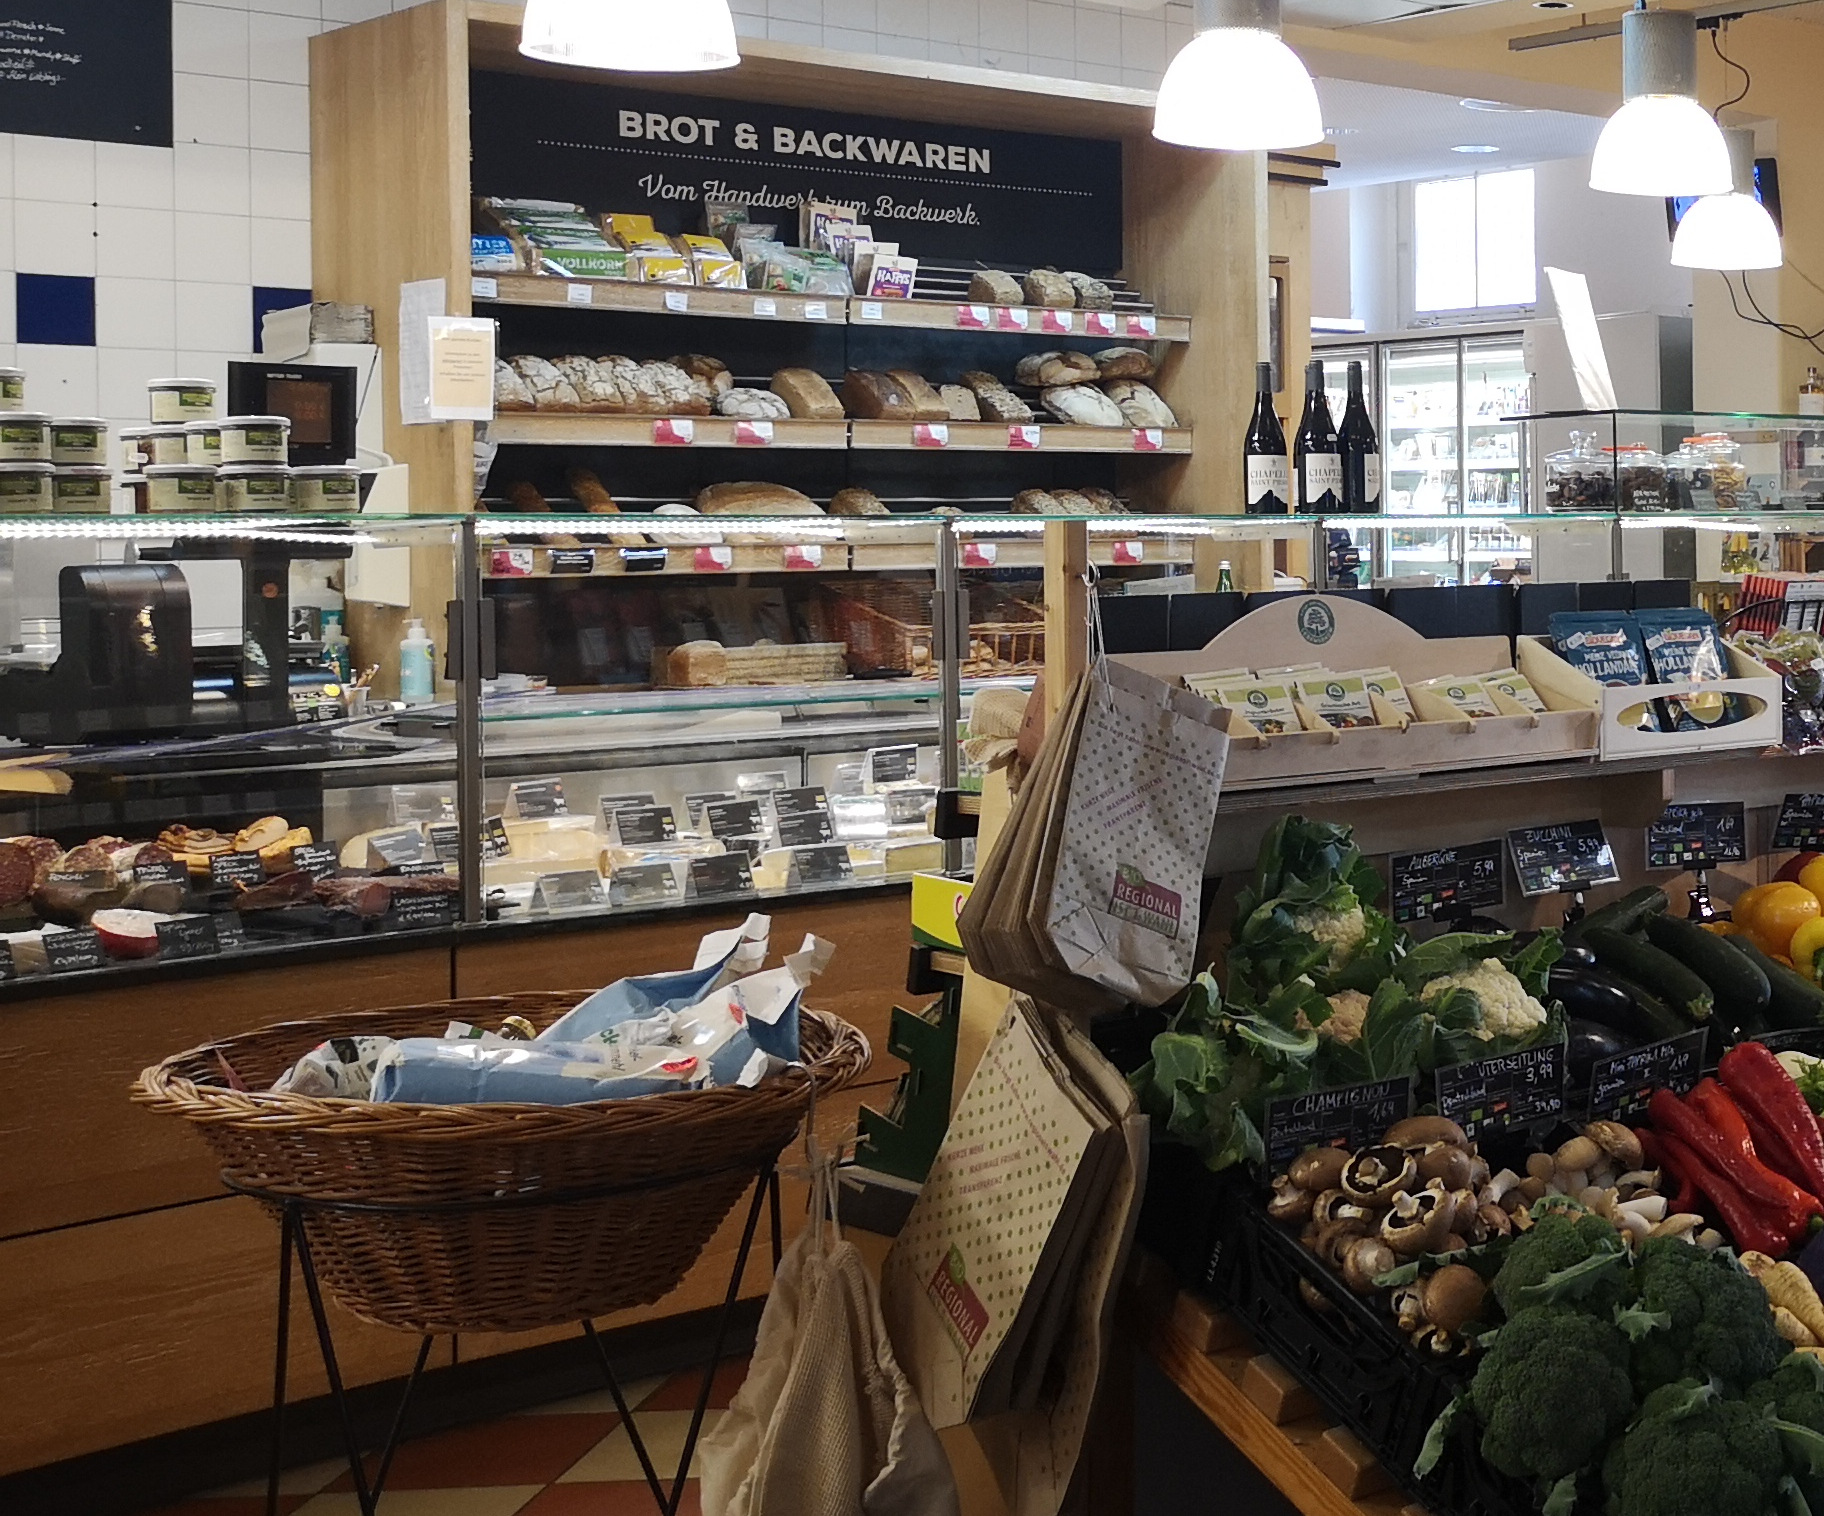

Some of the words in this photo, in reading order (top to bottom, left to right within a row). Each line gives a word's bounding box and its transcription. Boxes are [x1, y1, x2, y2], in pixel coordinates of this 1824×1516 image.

[619, 110, 720, 146] BROT
[734, 123, 759, 150] &
[773, 126, 991, 174] BACKWAREN
[638, 174, 698, 201] Vom
[874, 195, 981, 227] Backwerk.
[557, 255, 622, 270] VOLLKORN
[1524, 825, 1573, 843] ZUCCHINI
[1117, 883, 1178, 918] REGIONAL
[1525, 1063, 1553, 1085] 3,99
[1292, 1081, 1390, 1116] CHAMPIGNON
[935, 1270, 979, 1344] REGIONAL
